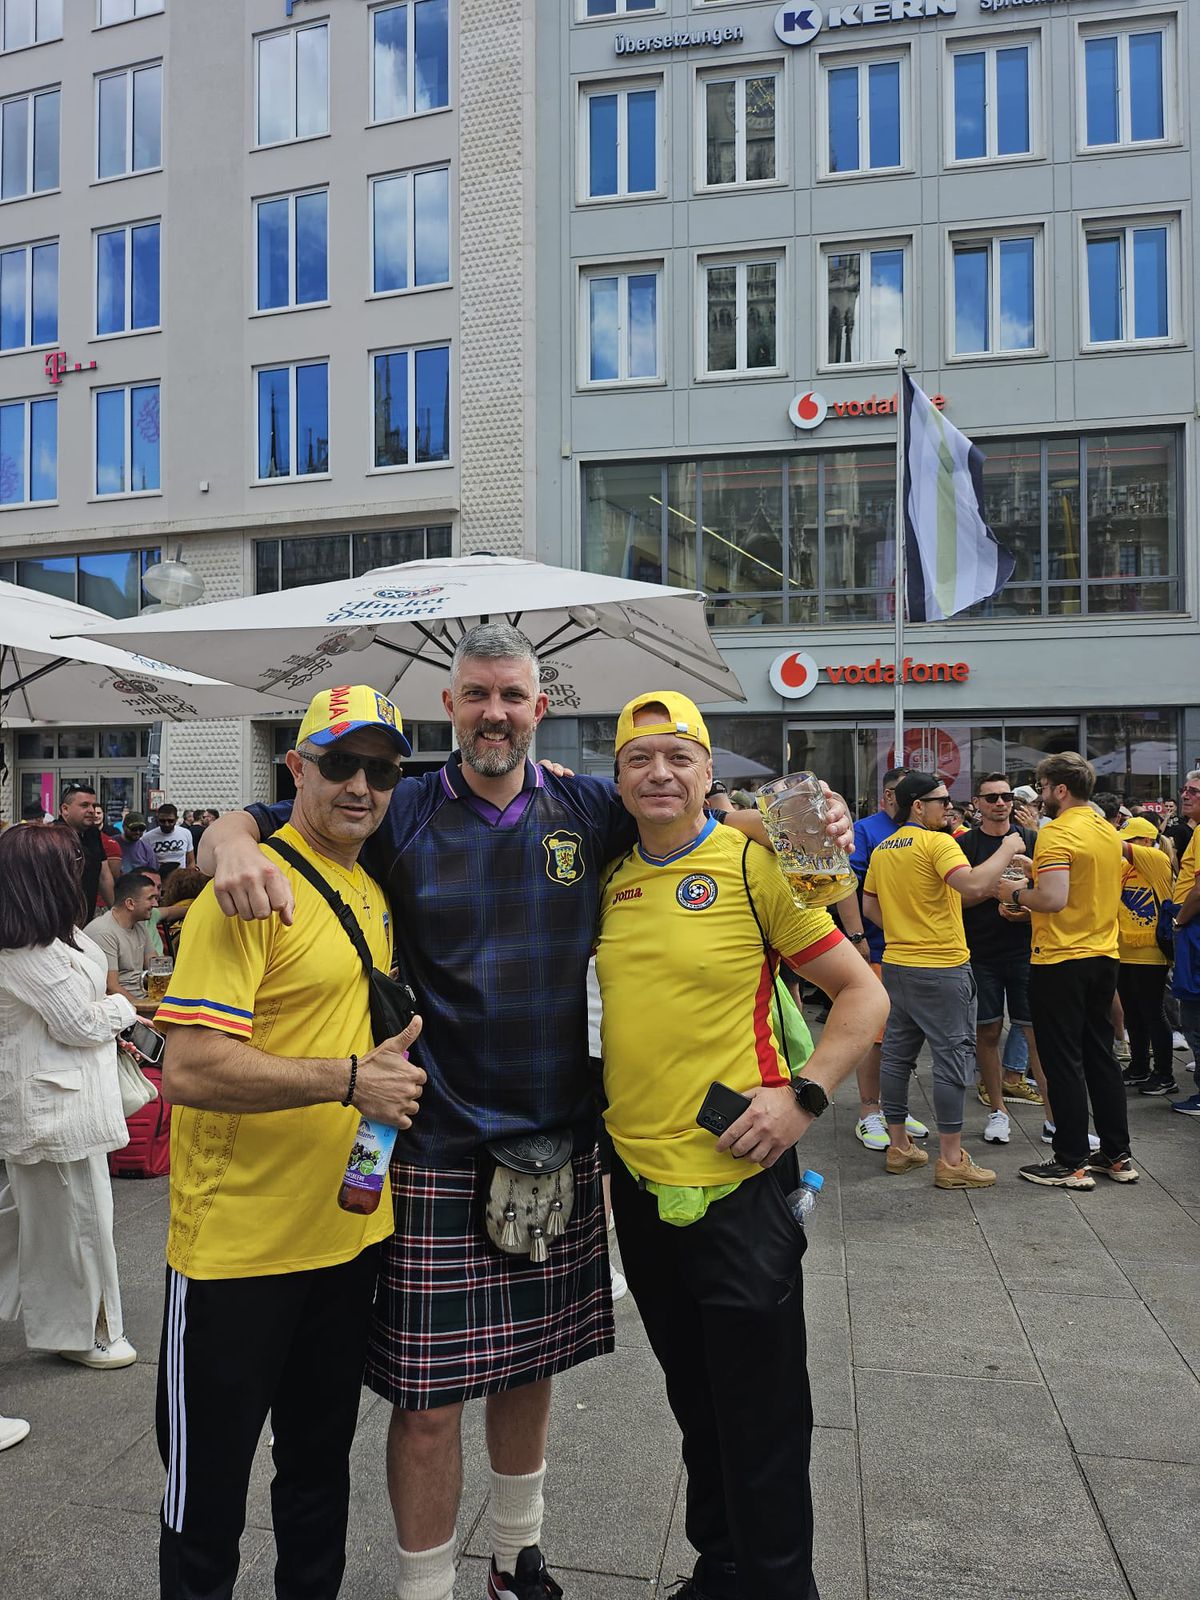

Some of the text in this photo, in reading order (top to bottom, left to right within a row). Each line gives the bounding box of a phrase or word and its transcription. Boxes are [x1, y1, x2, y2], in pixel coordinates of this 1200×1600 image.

[828, 0, 957, 30] KERN
[614, 25, 744, 55] Übersetzungen
[326, 606, 443, 623] Pschorr
[339, 597, 451, 613] Hacker
[826, 657, 970, 685] vodafone
